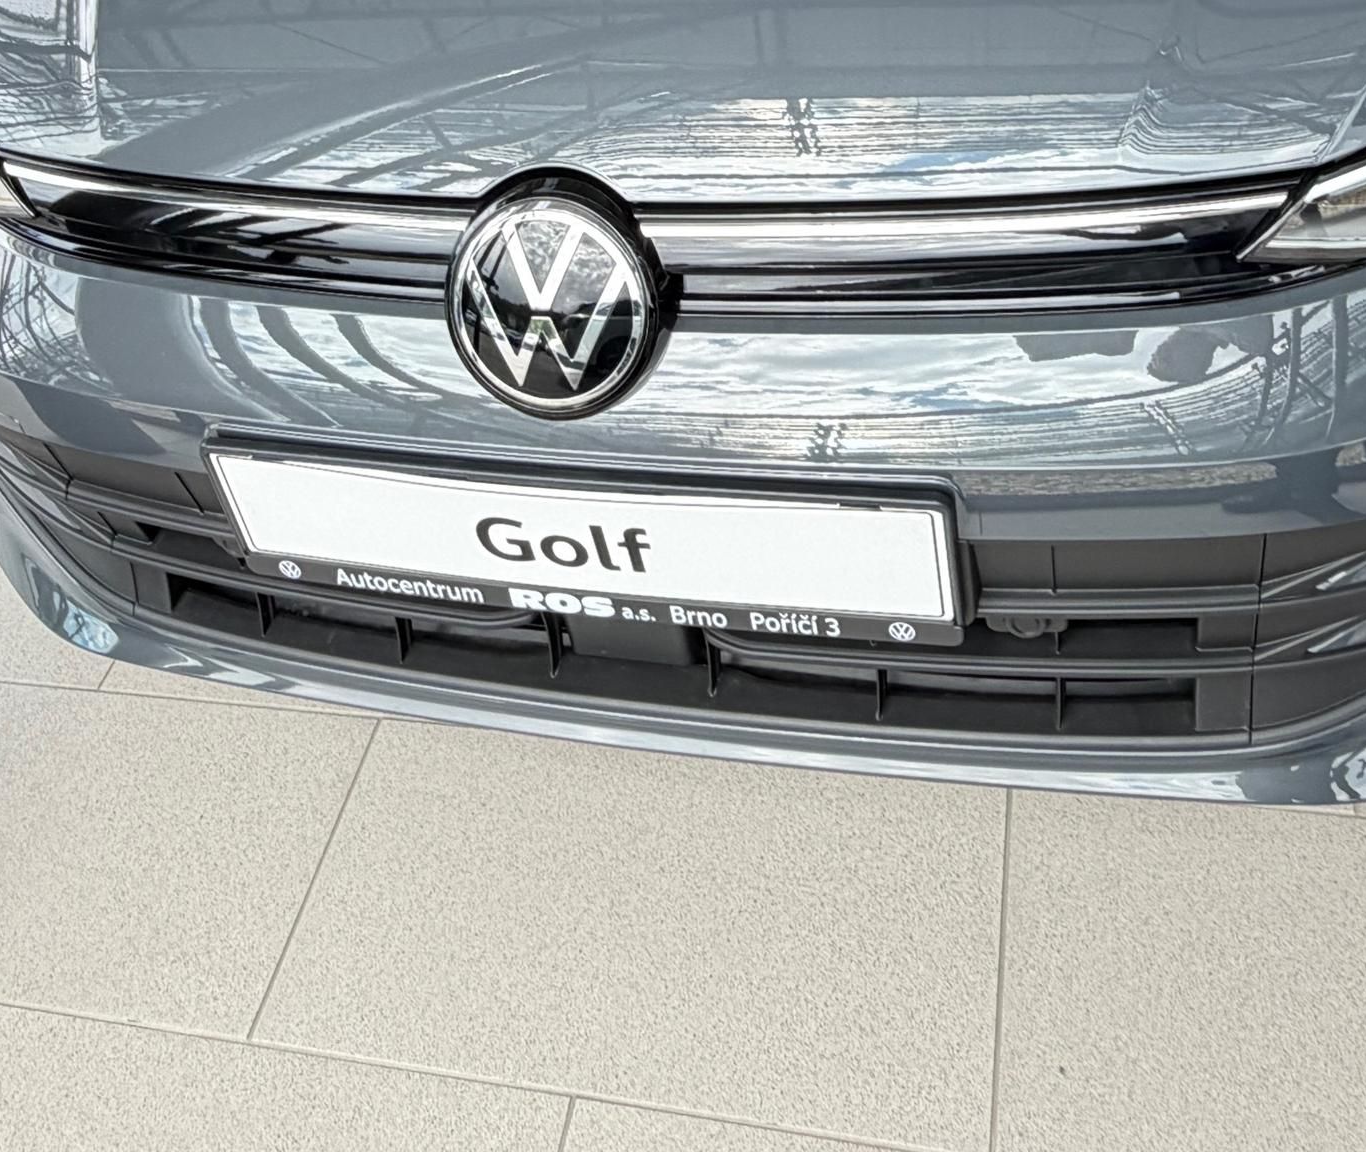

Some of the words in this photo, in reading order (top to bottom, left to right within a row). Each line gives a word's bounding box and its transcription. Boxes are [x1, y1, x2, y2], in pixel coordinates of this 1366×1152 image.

[475, 516, 651, 573] Golf
[336, 568, 485, 604] Autocentrum
[507, 587, 616, 618] ROS
[621, 606, 656, 622] a.s.
[669, 605, 728, 628] Brno
[749, 611, 819, 636] Poříčí
[824, 617, 841, 638] 3
